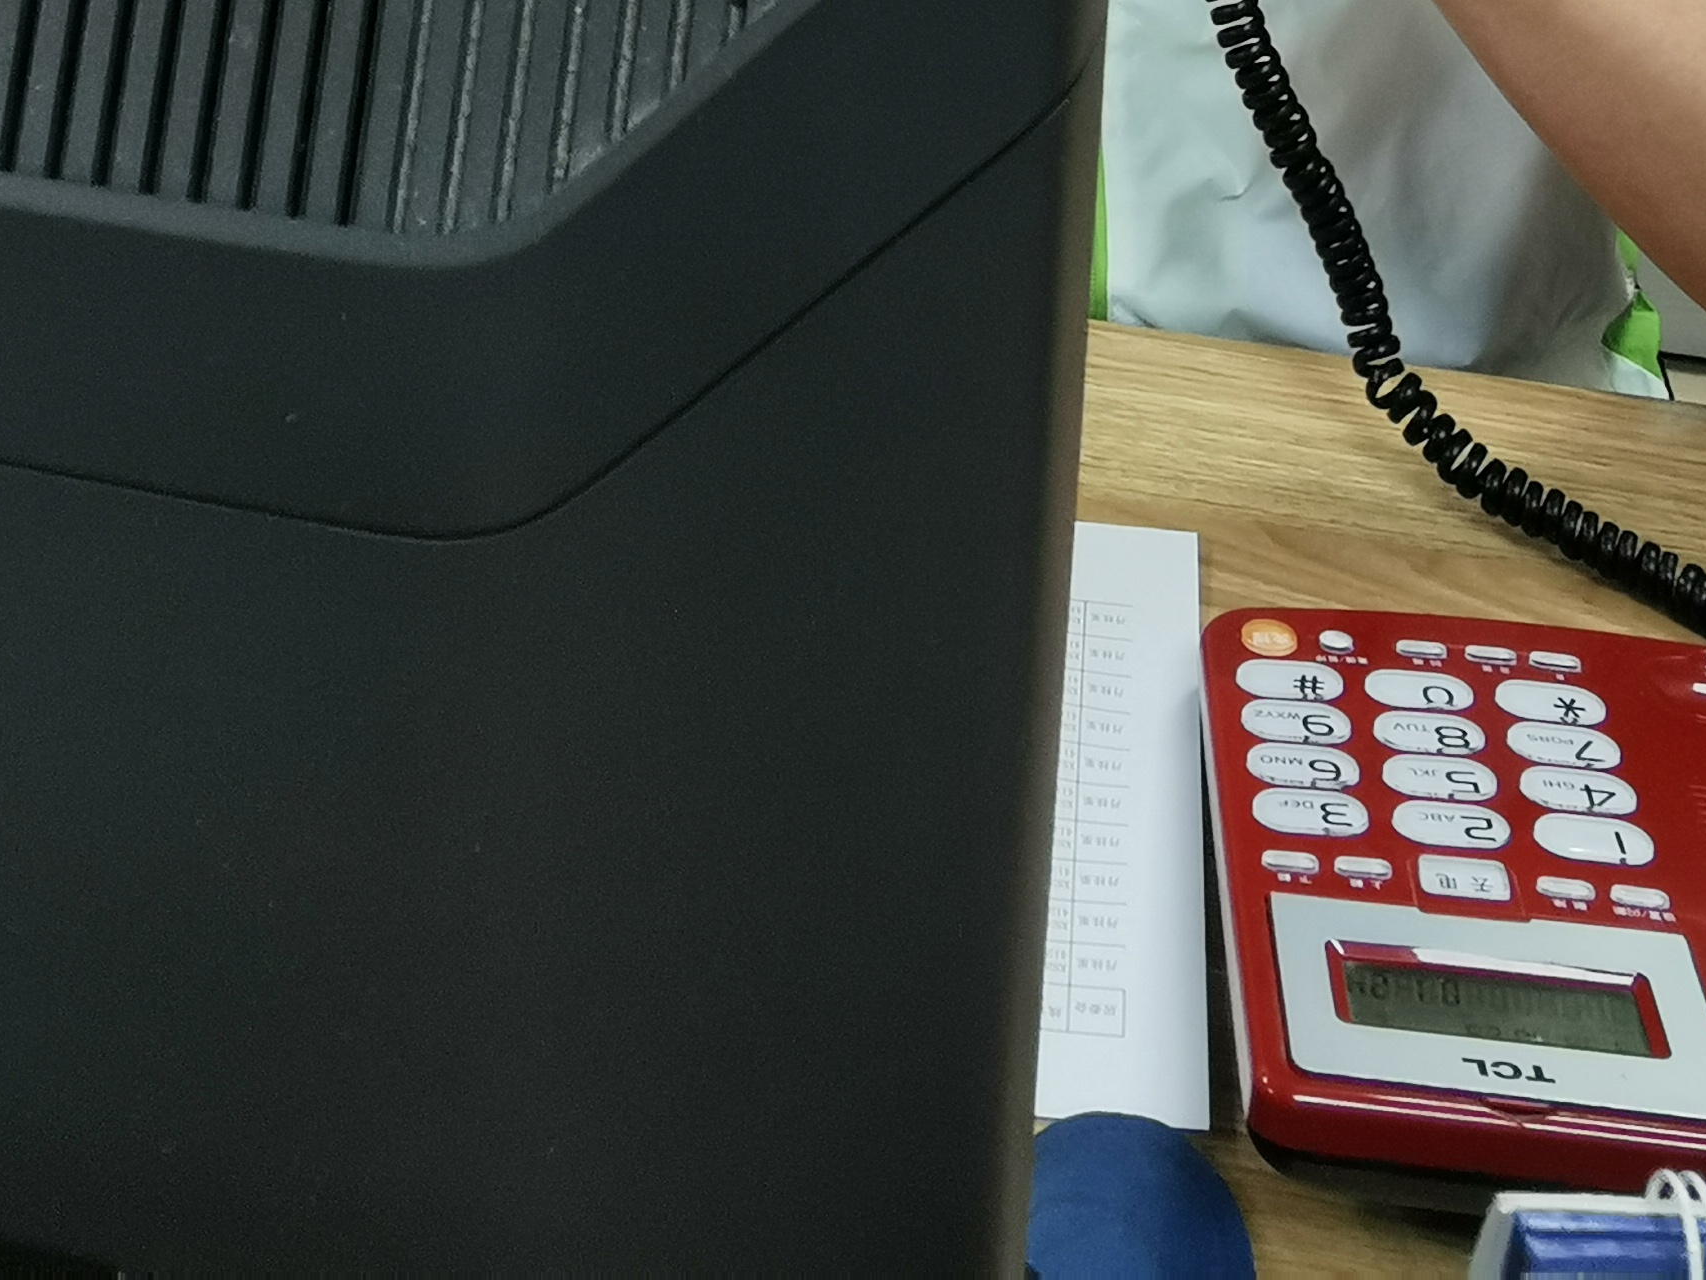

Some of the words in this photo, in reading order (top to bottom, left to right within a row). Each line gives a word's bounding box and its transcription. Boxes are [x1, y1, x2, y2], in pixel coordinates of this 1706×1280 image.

[1303, 715, 1334, 735] 9
[1435, 726, 1469, 748] 8
[1575, 740, 1605, 762] 7
[1309, 759, 1342, 782] 6
[1446, 770, 1480, 793] 5
[1580, 783, 1616, 808] 4
[1320, 802, 1352, 827] 3
[1460, 816, 1496, 842] 2
[1613, 831, 1627, 855] 1
[1461, 1057, 1556, 1085] TCL
